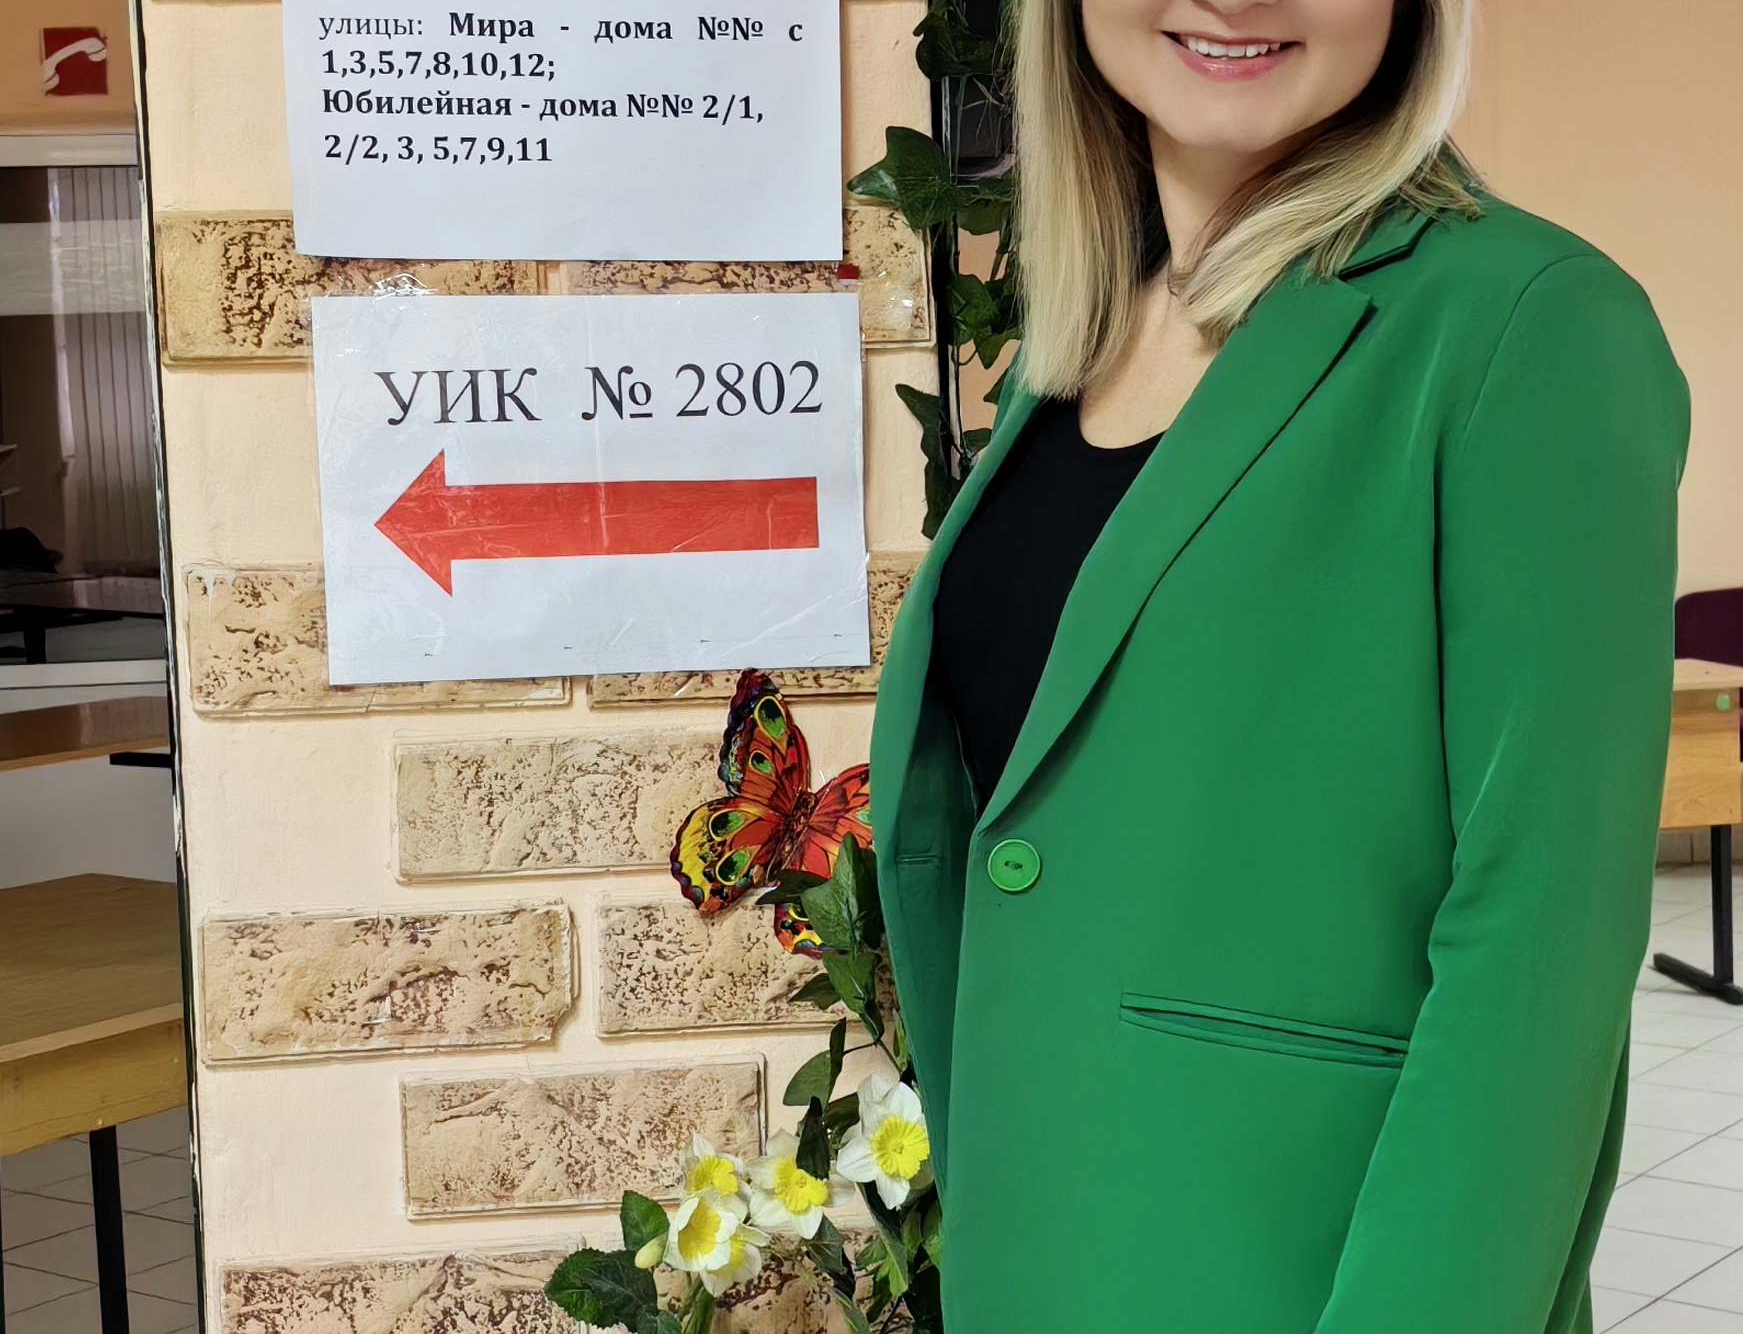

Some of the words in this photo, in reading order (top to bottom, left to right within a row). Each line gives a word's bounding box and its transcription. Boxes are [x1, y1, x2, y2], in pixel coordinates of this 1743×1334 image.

[318, 16, 423, 41] улицы:
[448, 11, 536, 45] Мира
[593, 20, 674, 45] дома
[696, 15, 764, 42] №№
[788, 23, 803, 42] с
[321, 49, 555, 83] 1,3,5,7,8,10,12;
[321, 88, 513, 117] Юбилейная
[538, 98, 619, 122] дома
[625, 93, 694, 119] №№
[702, 93, 764, 126] 2/1,
[324, 133, 389, 166] 2/2,
[396, 135, 424, 165] 3,
[432, 135, 553, 166] 5,7,9,11
[372, 367, 543, 427] УИК
[580, 364, 654, 422] №
[675, 359, 823, 418] 2802
